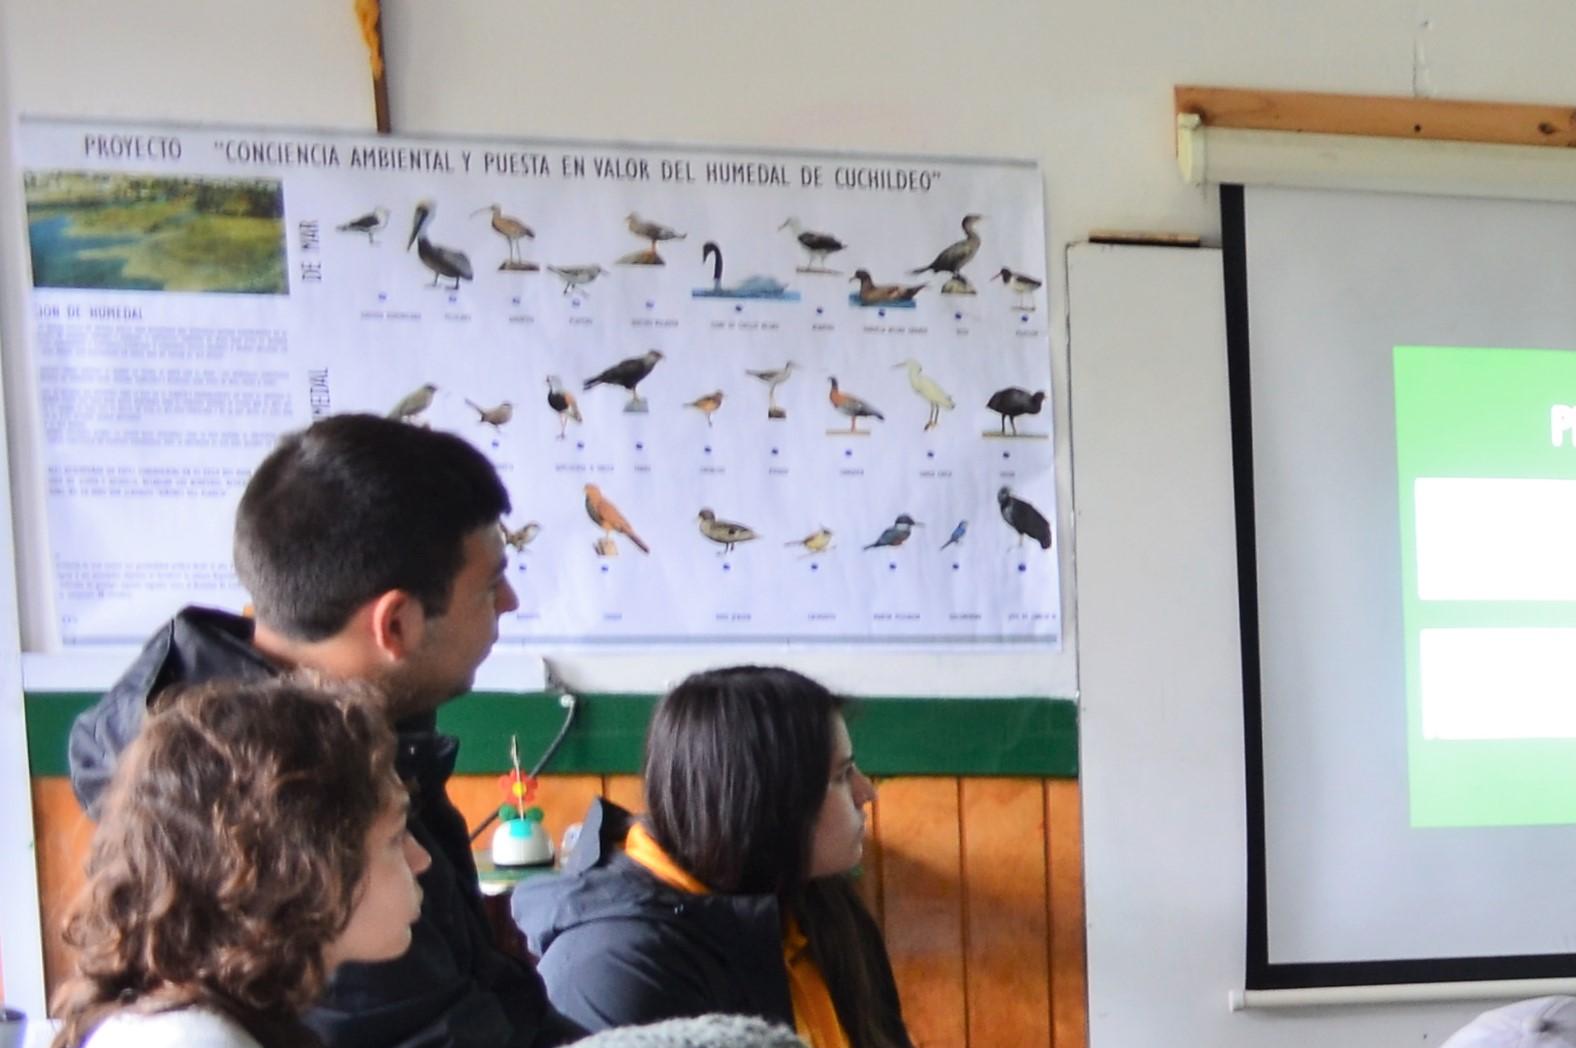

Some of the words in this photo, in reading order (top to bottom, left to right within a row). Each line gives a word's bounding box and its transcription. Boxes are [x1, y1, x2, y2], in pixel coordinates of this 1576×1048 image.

[84, 134, 182, 160] PROYECTO
[350, 146, 454, 172] AMBIENTAL
[461, 151, 471, 172] Y
[484, 152, 550, 177] PUESTA
[562, 154, 585, 178] EN
[594, 156, 650, 181] VALOR
[661, 160, 695, 184] DEL
[706, 161, 791, 187] HUMEDAL
[800, 164, 823, 188] DE
